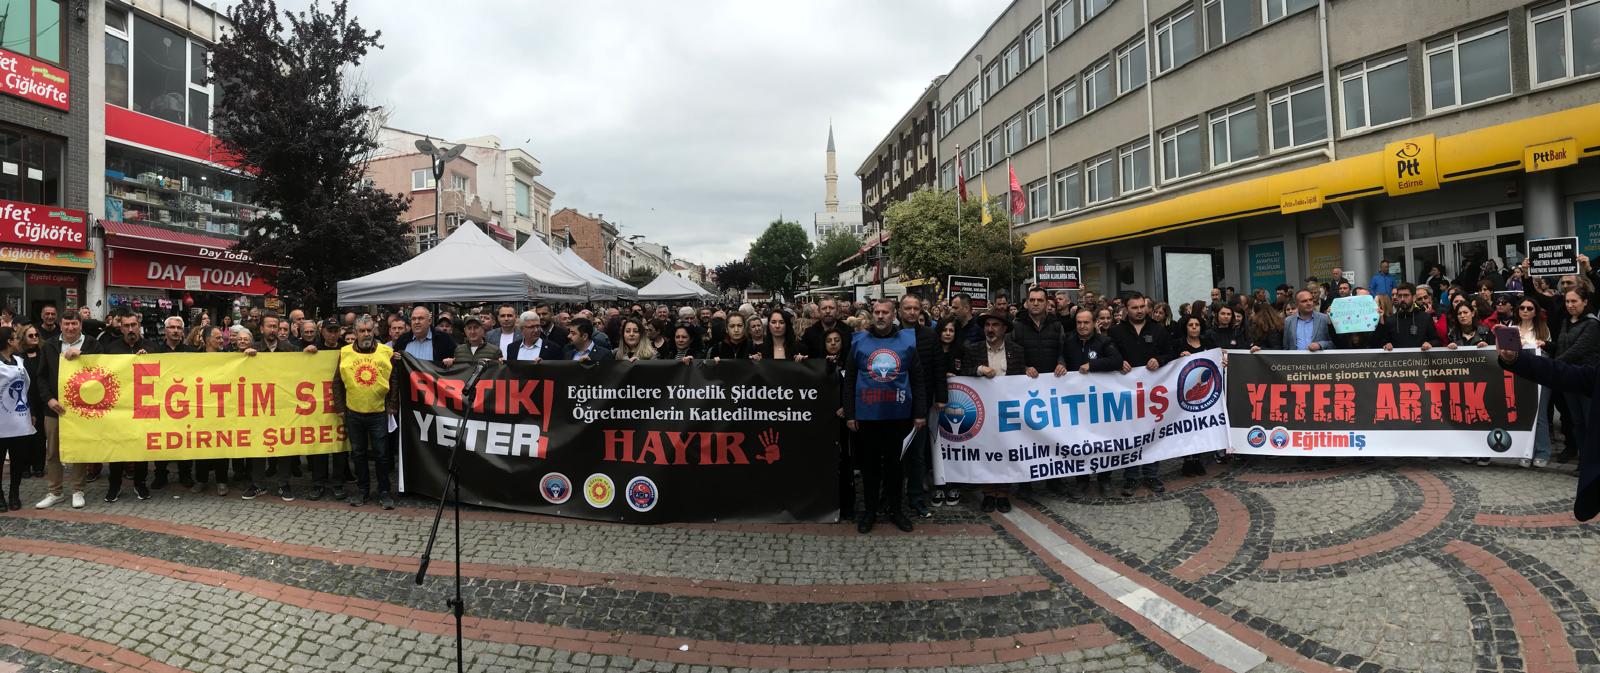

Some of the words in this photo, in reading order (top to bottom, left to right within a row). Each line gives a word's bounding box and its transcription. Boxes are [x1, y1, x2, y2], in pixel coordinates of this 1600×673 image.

[0, 52, 17, 73] et
[5, 73, 67, 104] Çiğköfte
[1398, 180, 1424, 190] Edirne
[14, 221, 83, 243] Çiğköfte
[0, 246, 51, 260] Çiğköfte
[199, 248, 222, 259] Day
[224, 250, 252, 262] Toda
[147, 261, 187, 282] DAY
[201, 267, 255, 287] TODAY
[1270, 361, 1328, 372] ÖĞRETMENLERİ
[1329, 361, 1376, 370] KORURSANIZ
[1378, 358, 1430, 368] GELECEĞİNİZİ
[1432, 356, 1486, 365] KORURSUNUZ
[1286, 371, 1333, 381] EĞİTİMDE
[1335, 370, 1370, 381] ŞİDDET
[1373, 369, 1419, 379] YASASINI
[1421, 367, 1470, 379] ÇIKARTIN
[132, 360, 276, 421] EĞİTİM
[295, 380, 337, 416] SE
[567, 384, 662, 403] Eğitimcilere
[666, 384, 726, 400] Yönelik
[730, 384, 794, 404] Şiddete
[799, 388, 818, 400] ve
[572, 403, 684, 424] Öğretmenlerin
[689, 407, 812, 422] Katledilmesine
[998, 381, 1170, 433] EĞİTİMİŞ
[1246, 383, 1356, 424] YETER
[1373, 382, 1492, 424] ARTIK
[146, 424, 251, 451] EDİRNE
[262, 424, 347, 453] ŞUBES
[602, 428, 750, 465] HAYIR
[985, 451, 1003, 462] ve
[1008, 442, 1050, 462] BİLİM
[1055, 430, 1155, 459] İŞGÖRENLERİ
[1158, 412, 1226, 439] SENDİKAS
[1029, 458, 1085, 479] EDİRNE
[1089, 447, 1143, 474] ŞUBESİ
